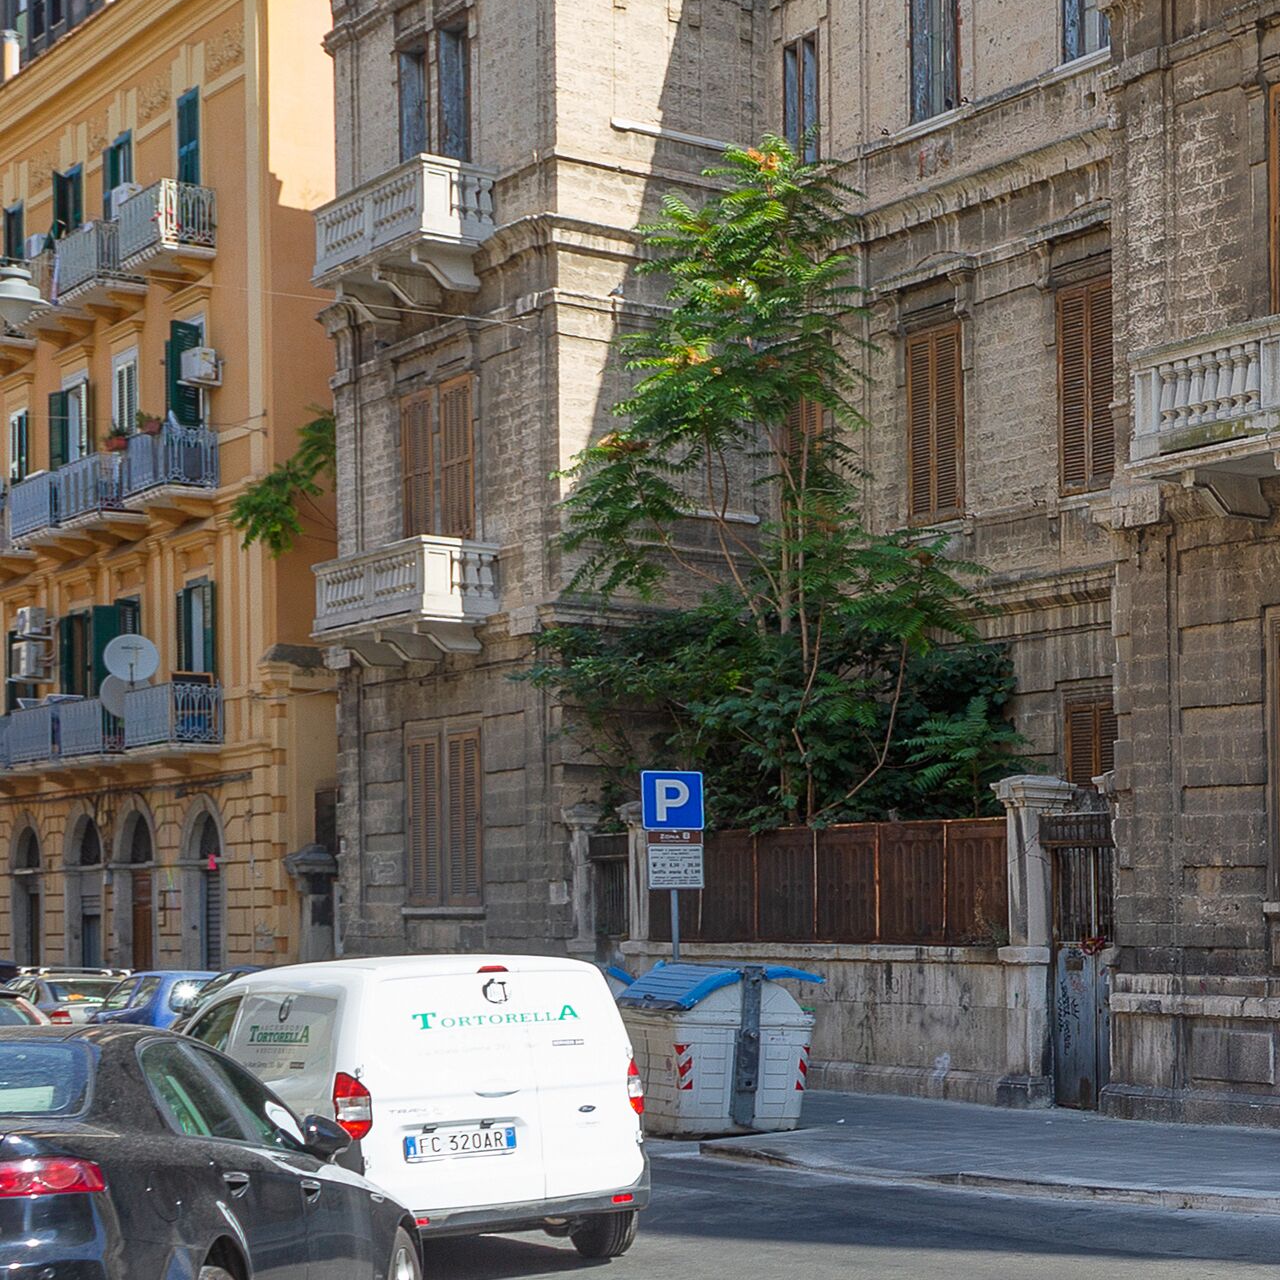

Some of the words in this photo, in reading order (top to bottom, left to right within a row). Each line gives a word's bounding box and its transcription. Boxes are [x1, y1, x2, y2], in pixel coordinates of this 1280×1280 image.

[655, 779, 690, 822] P
[411, 1004, 581, 1031] TORTORELLA
[249, 1024, 310, 1043] TORTORELLA
[419, 1137, 441, 1154] FC
[449, 1131, 504, 1151] 320AR
